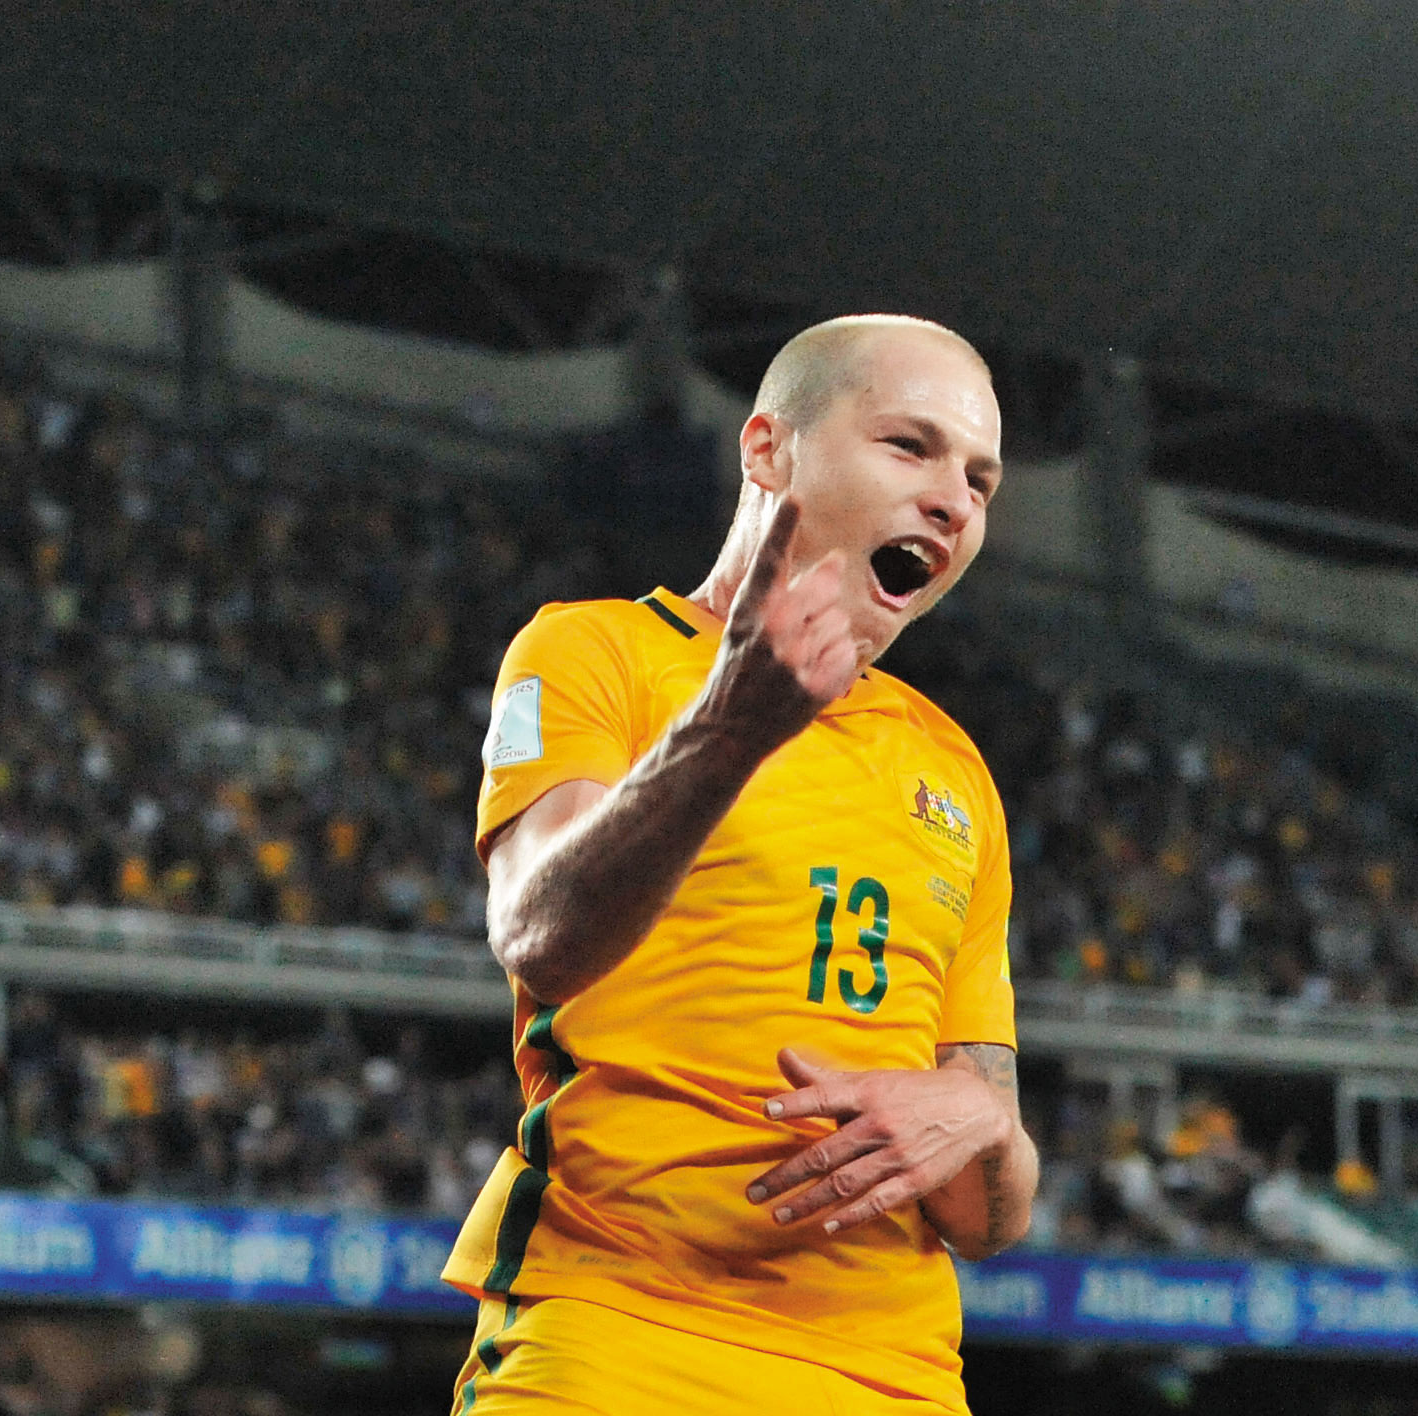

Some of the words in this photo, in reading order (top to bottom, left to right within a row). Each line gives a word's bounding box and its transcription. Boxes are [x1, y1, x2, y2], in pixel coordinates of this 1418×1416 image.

[806, 866, 890, 1015] 13
[132, 1215, 315, 1278] Allianz
[1081, 1267, 1237, 1329] Allianz
